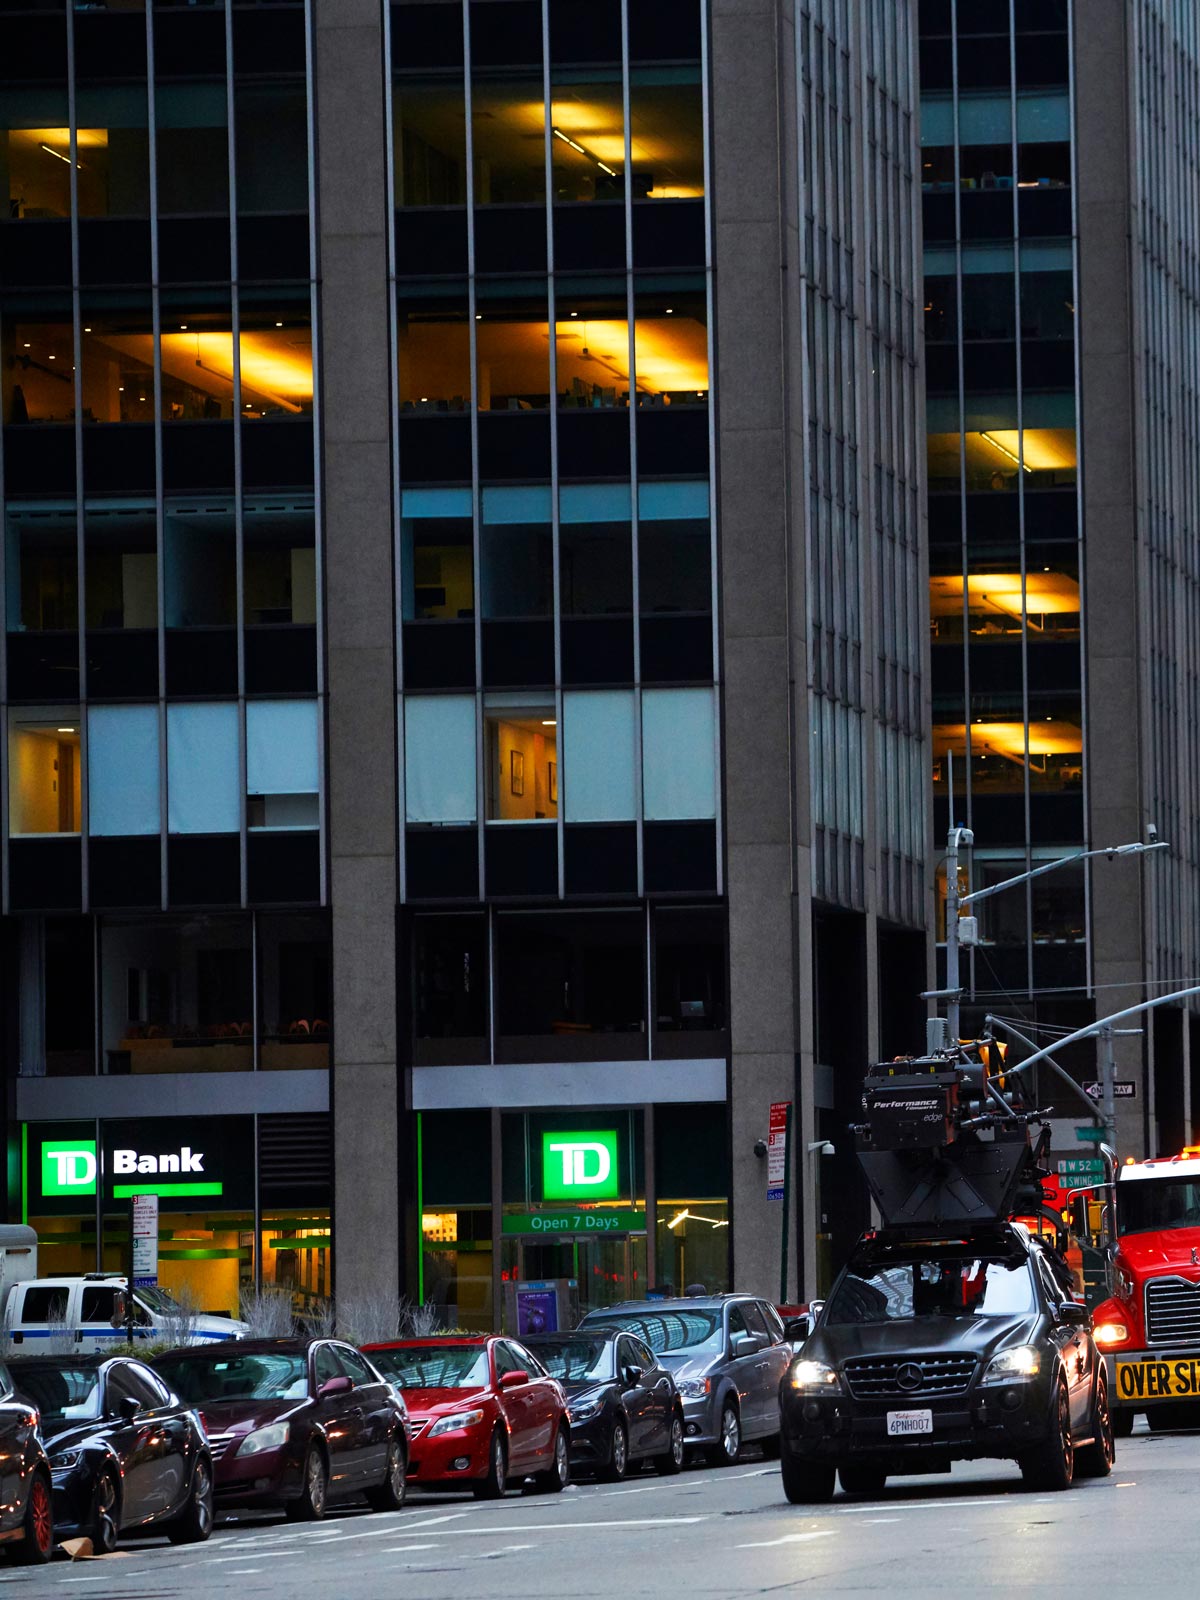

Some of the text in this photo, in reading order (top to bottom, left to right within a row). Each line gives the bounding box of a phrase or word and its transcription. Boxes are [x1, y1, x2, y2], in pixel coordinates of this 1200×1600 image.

[873, 1099, 938, 1109] Performance
[923, 1112, 943, 1123] edge
[47, 1146, 205, 1185] TD Bank
[549, 1142, 611, 1186] TD
[1068, 1161, 1076, 1171] W
[1079, 1160, 1091, 1171] 52
[1068, 1176, 1093, 1187] SWING
[531, 1215, 620, 1231] Open 7 Days
[1120, 1362, 1172, 1397] OVER
[890, 1418, 930, 1432] 6PNH007
